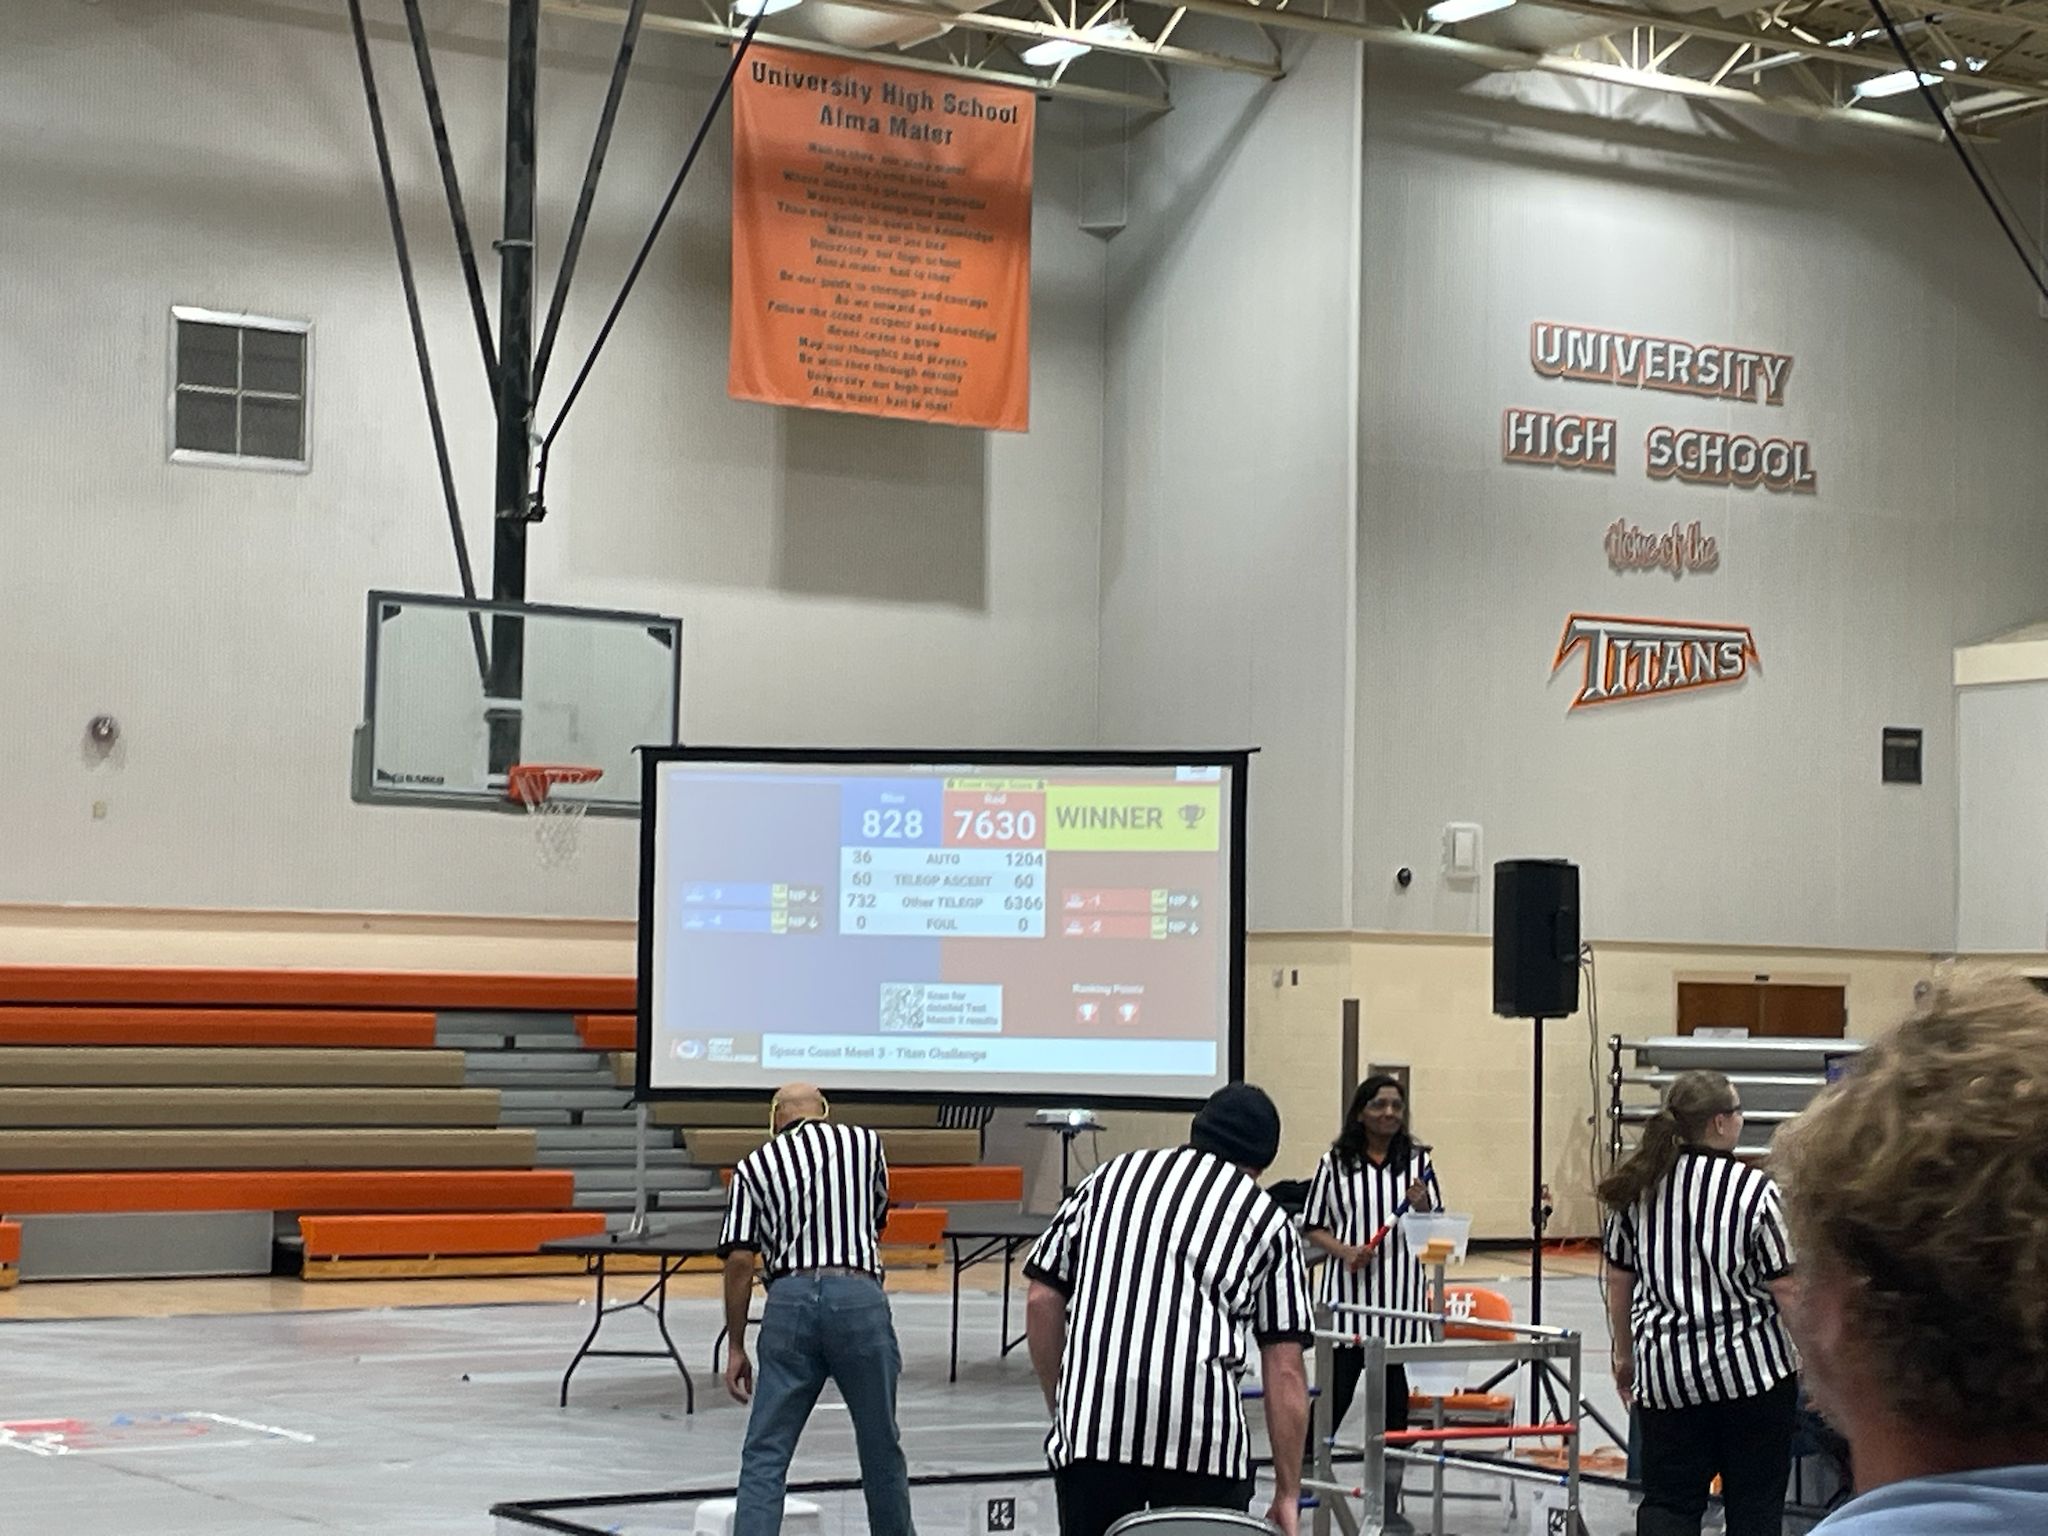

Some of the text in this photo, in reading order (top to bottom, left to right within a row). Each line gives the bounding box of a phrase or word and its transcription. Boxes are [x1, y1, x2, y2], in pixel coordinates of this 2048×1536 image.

[751, 61, 1018, 124] University High School
[820, 105, 952, 145] Alma Mater
[1533, 323, 1793, 404] UNIVERSITY
[1504, 409, 1816, 492] HIGH SCHOOL
[1554, 614, 1758, 708] TITANS
[984, 794, 1007, 805] Red
[862, 809, 923, 839] 828
[953, 810, 1037, 840] 7630
[1056, 806, 1163, 830] WINNER
[852, 850, 873, 864] 36
[926, 854, 960, 866] AUTO
[1006, 852, 1044, 867] 1204
[852, 872, 872, 886] 60
[894, 875, 992, 887] TELEOP ASCENT
[1014, 875, 1034, 889] 60
[847, 894, 877, 908] 732
[902, 897, 984, 909] Other TELEOP
[1004, 897, 1043, 911] 6366
[856, 916, 866, 929] 0
[926, 918, 958, 930] FOUL
[1018, 918, 1028, 932] 0
[769, 1044, 804, 1059] Space
[807, 1045, 841, 1058] Coast
[845, 1046, 875, 1058] Meet
[896, 1047, 926, 1059] Titan
[928, 1048, 987, 1063] Challenge
